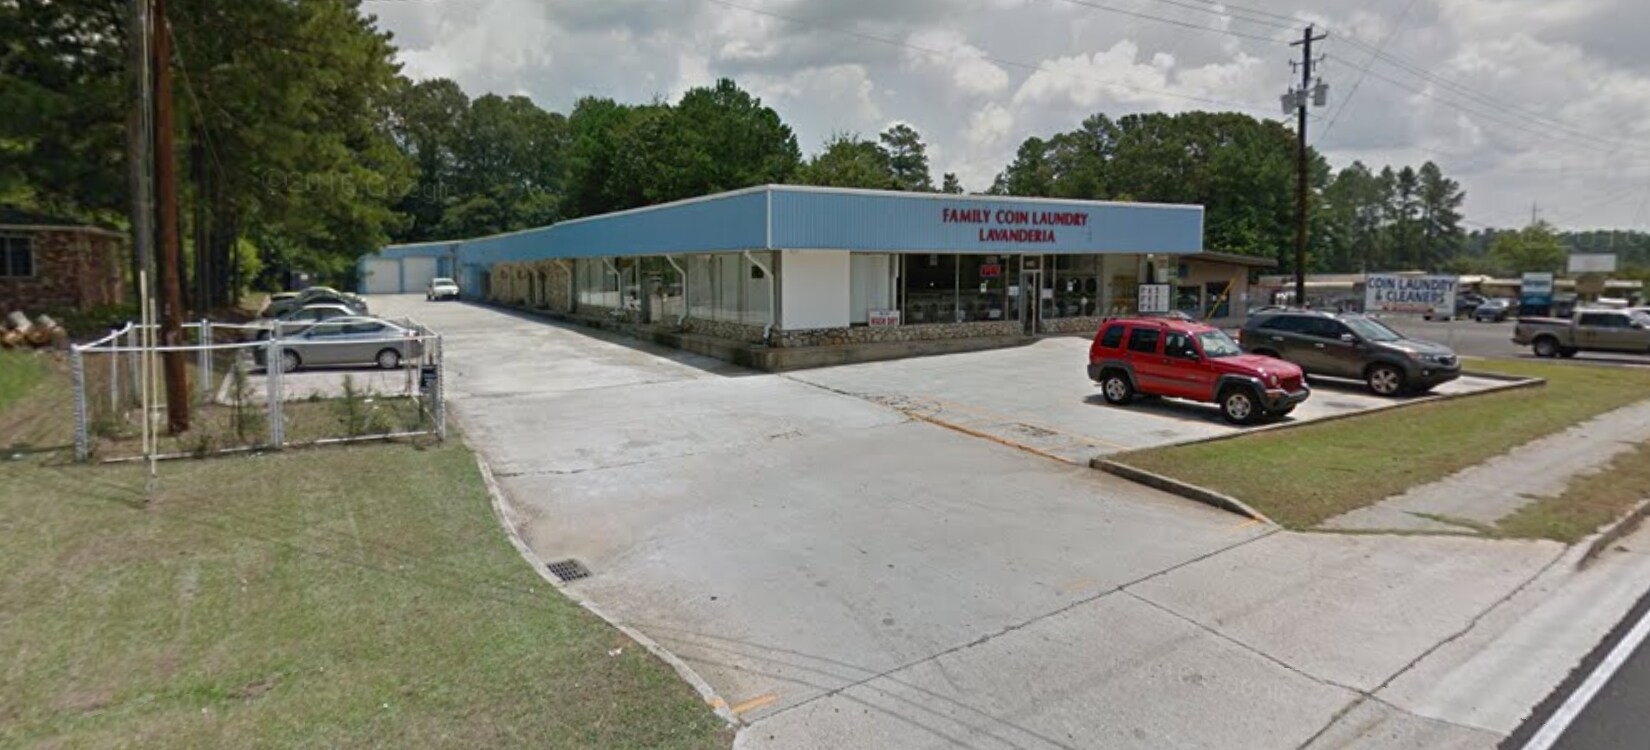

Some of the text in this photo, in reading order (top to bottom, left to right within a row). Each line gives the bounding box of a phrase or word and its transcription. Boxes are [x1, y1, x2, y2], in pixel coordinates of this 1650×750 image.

[942, 208, 1089, 226] FAMILY COIN LAUNDRY
[979, 227, 1056, 243] LAVANDERIA
[1367, 277, 1456, 292] COIN LAUNDRY
[1386, 288, 1445, 303] CLEANERS
